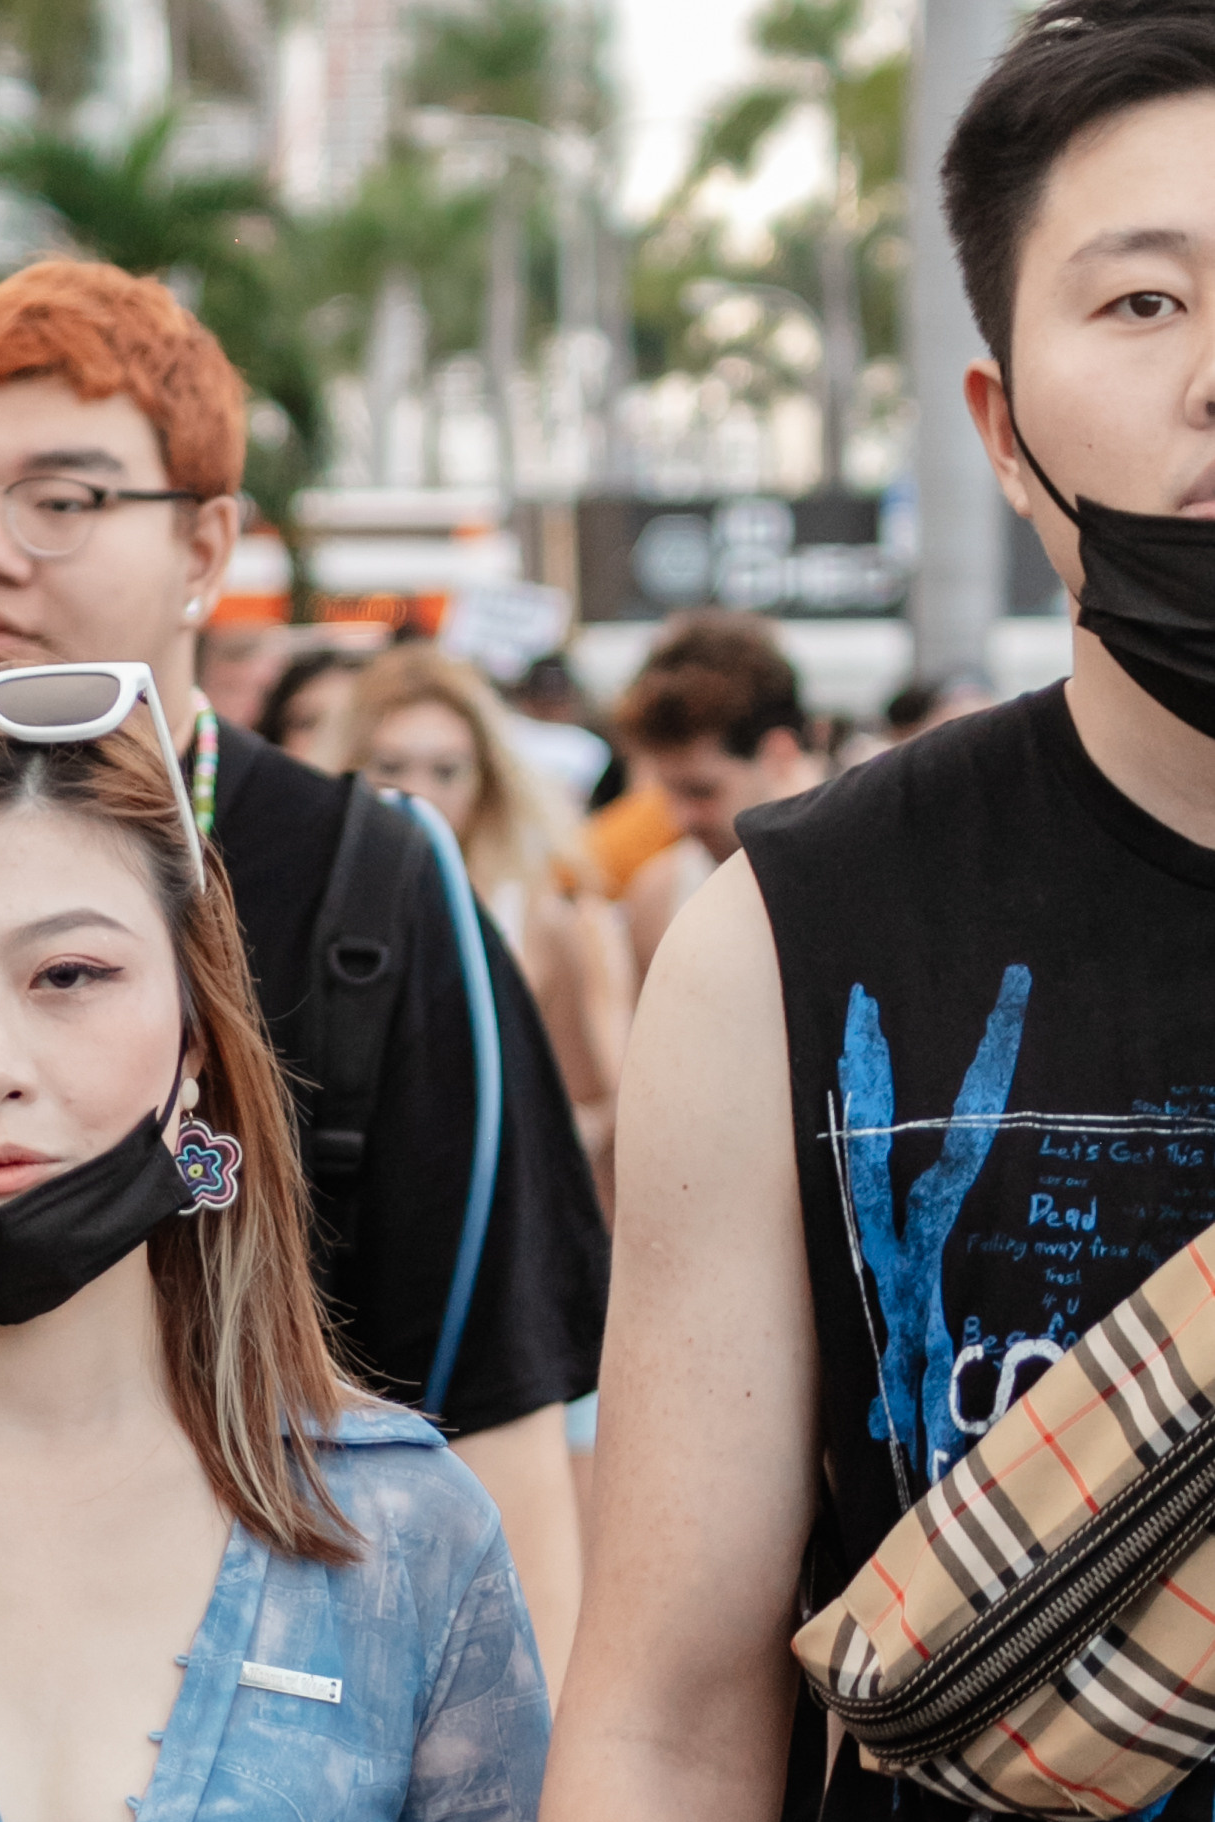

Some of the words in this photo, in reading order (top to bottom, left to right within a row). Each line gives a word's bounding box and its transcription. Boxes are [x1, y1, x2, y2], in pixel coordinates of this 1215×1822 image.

[1039, 1134, 1101, 1162] Let's
[1109, 1140, 1155, 1165] Get
[1028, 1193, 1097, 1232] Dead
[1033, 1233, 1083, 1261] away
